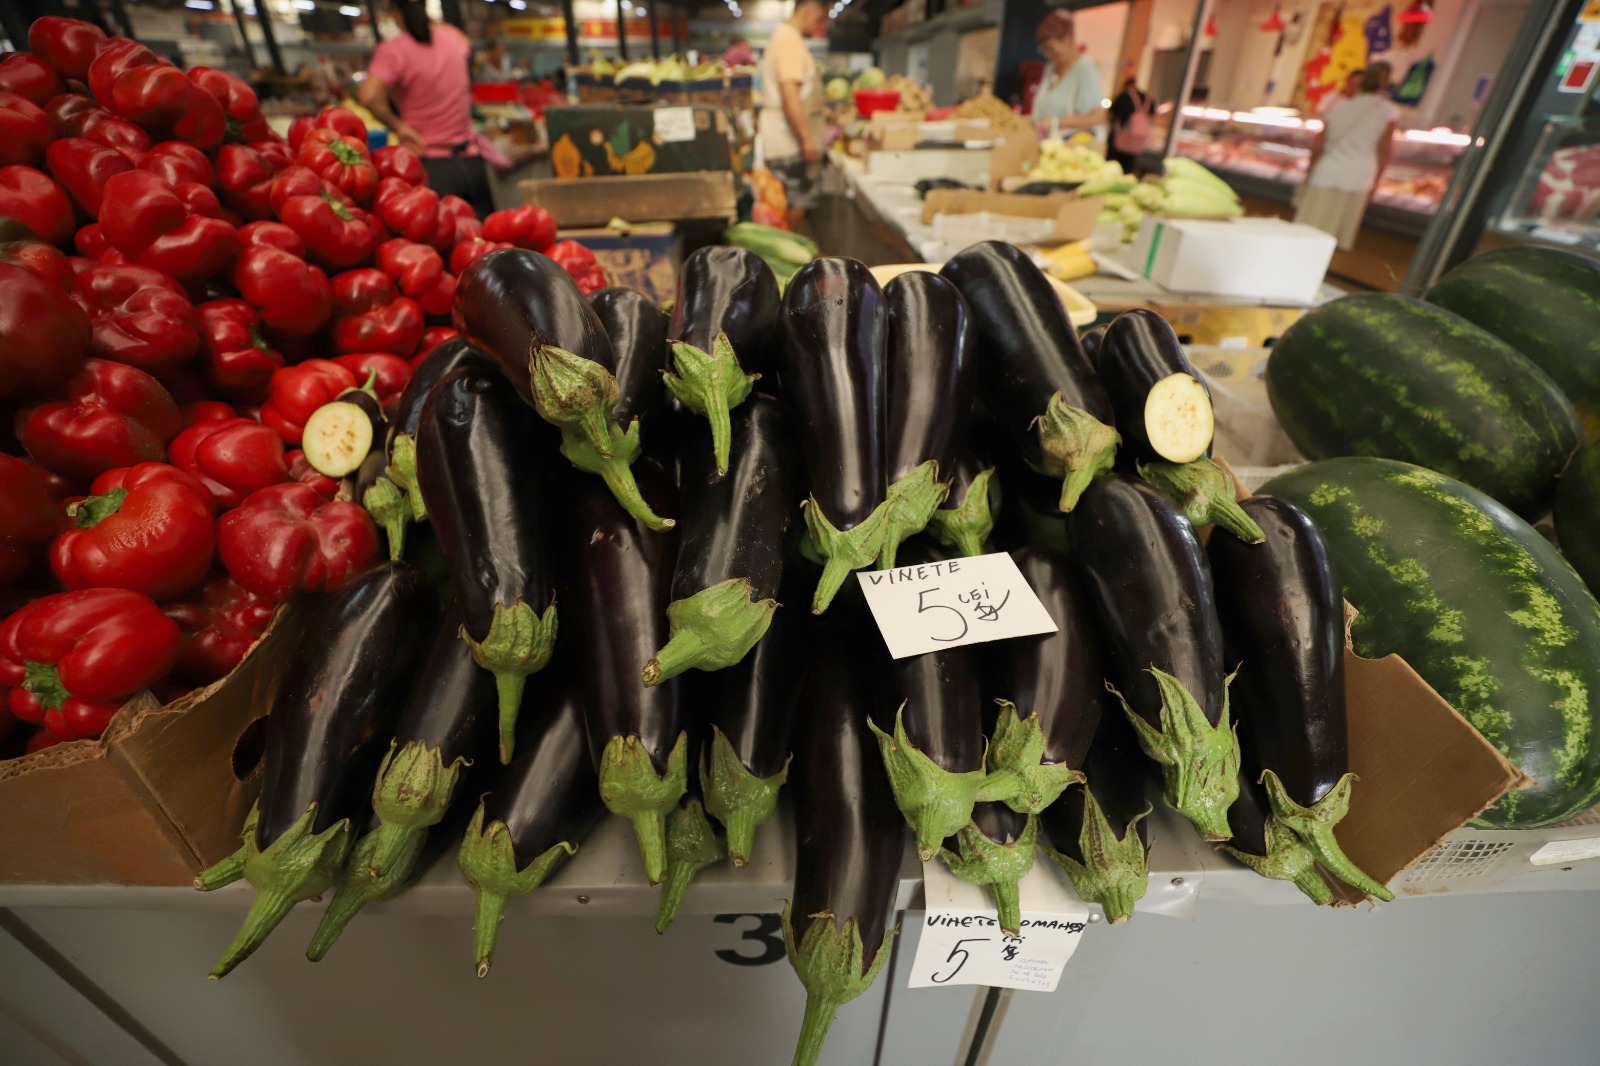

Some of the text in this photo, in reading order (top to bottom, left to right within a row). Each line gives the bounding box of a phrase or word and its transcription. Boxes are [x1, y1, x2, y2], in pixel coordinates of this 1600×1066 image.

[917, 587, 969, 642] 5
[713, 912, 788, 967] 3
[931, 938, 991, 984] 5
